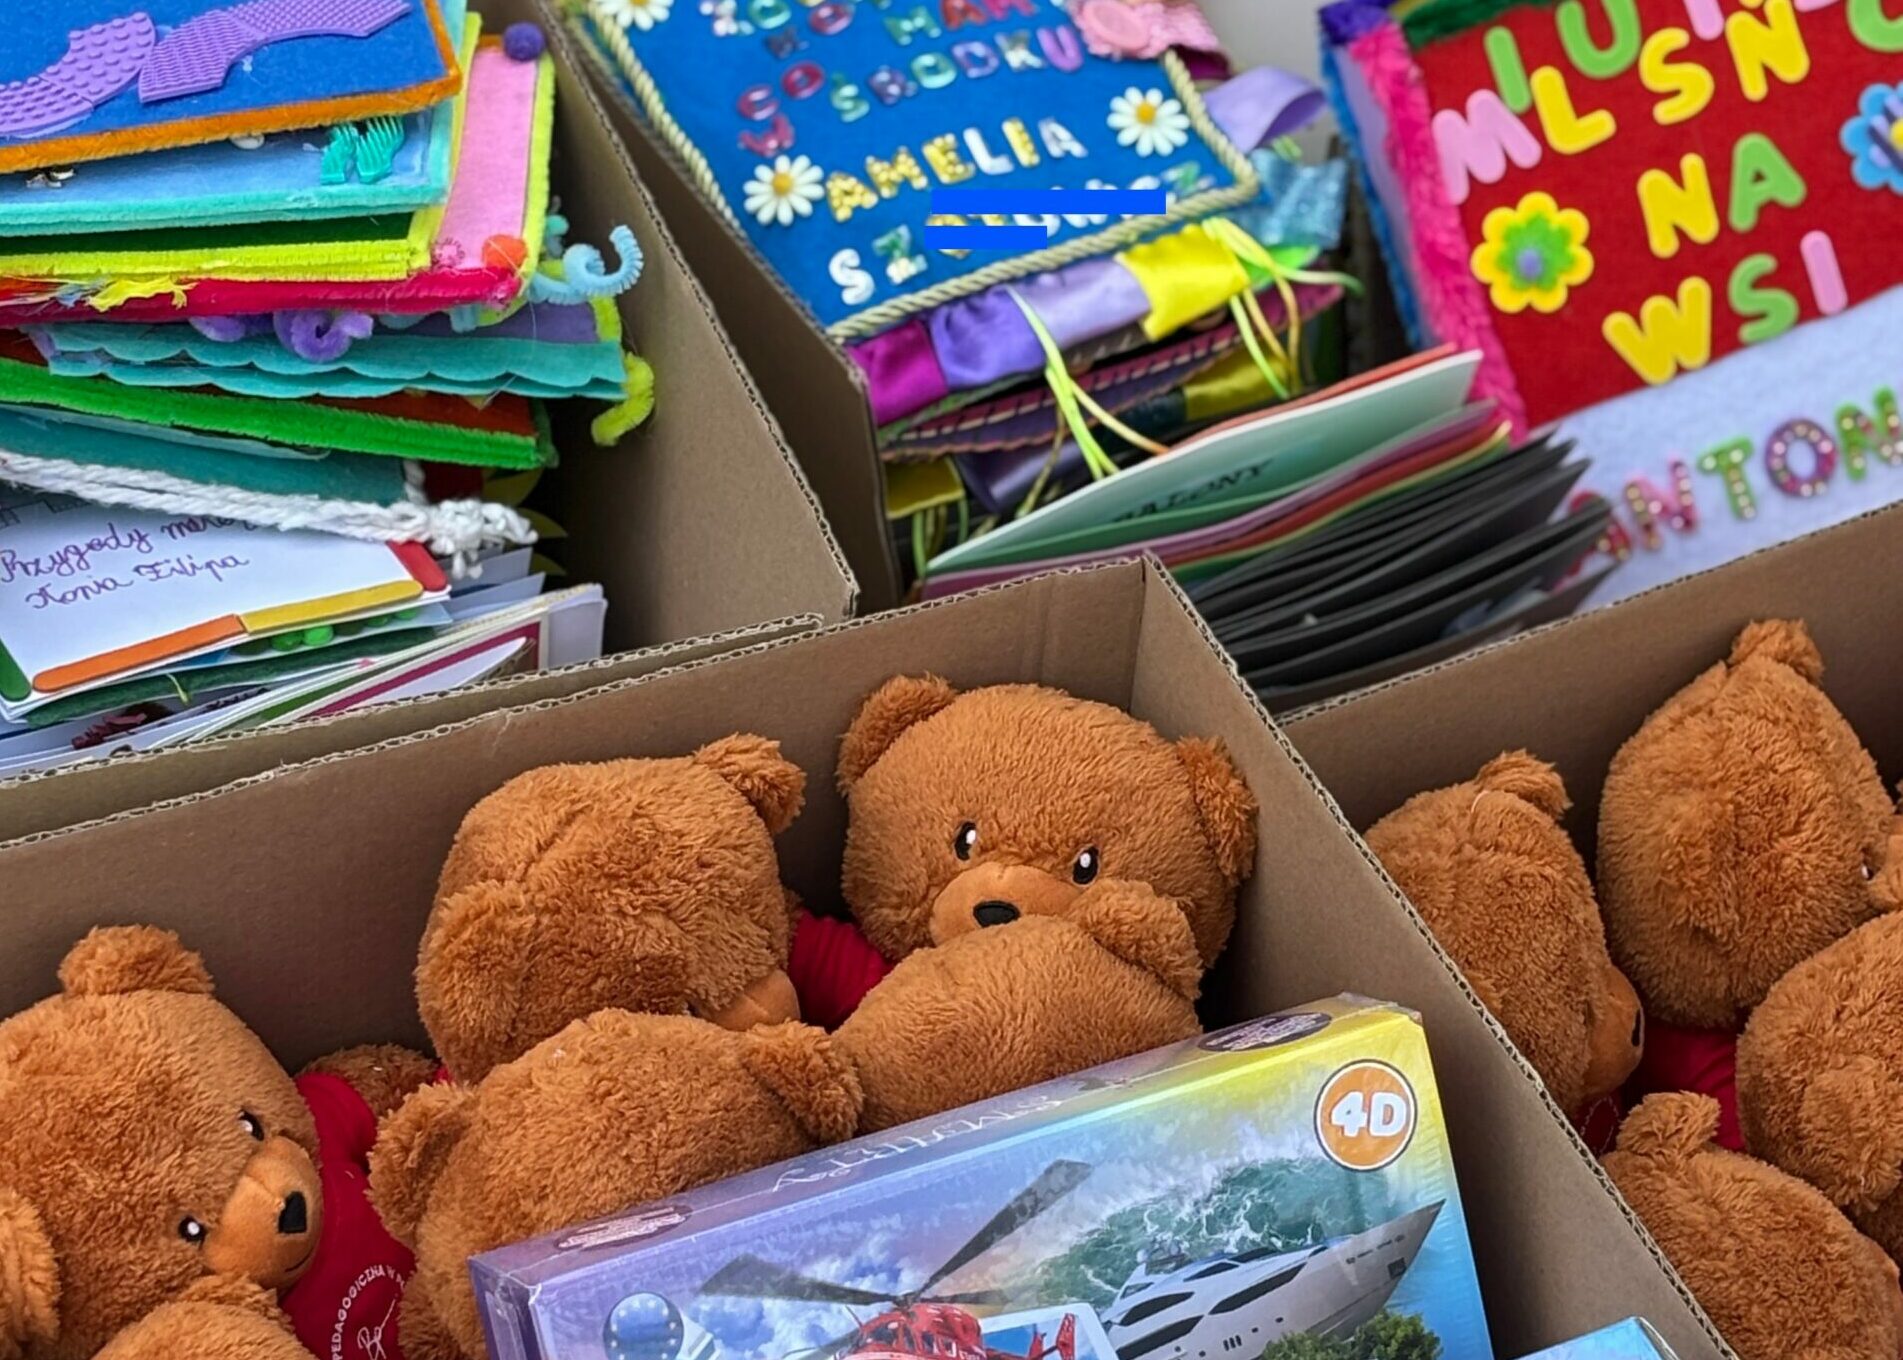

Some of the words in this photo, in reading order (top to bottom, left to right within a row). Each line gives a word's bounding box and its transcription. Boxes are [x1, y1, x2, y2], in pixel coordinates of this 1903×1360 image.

[824, 116, 1089, 222] AMELIA
[1637, 133, 1806, 259] NA
[1602, 230, 1848, 385] WSI
[1, 522, 154, 583] Przygody
[133, 554, 250, 582] Filipa
[1331, 1091, 1407, 1137] 4D
